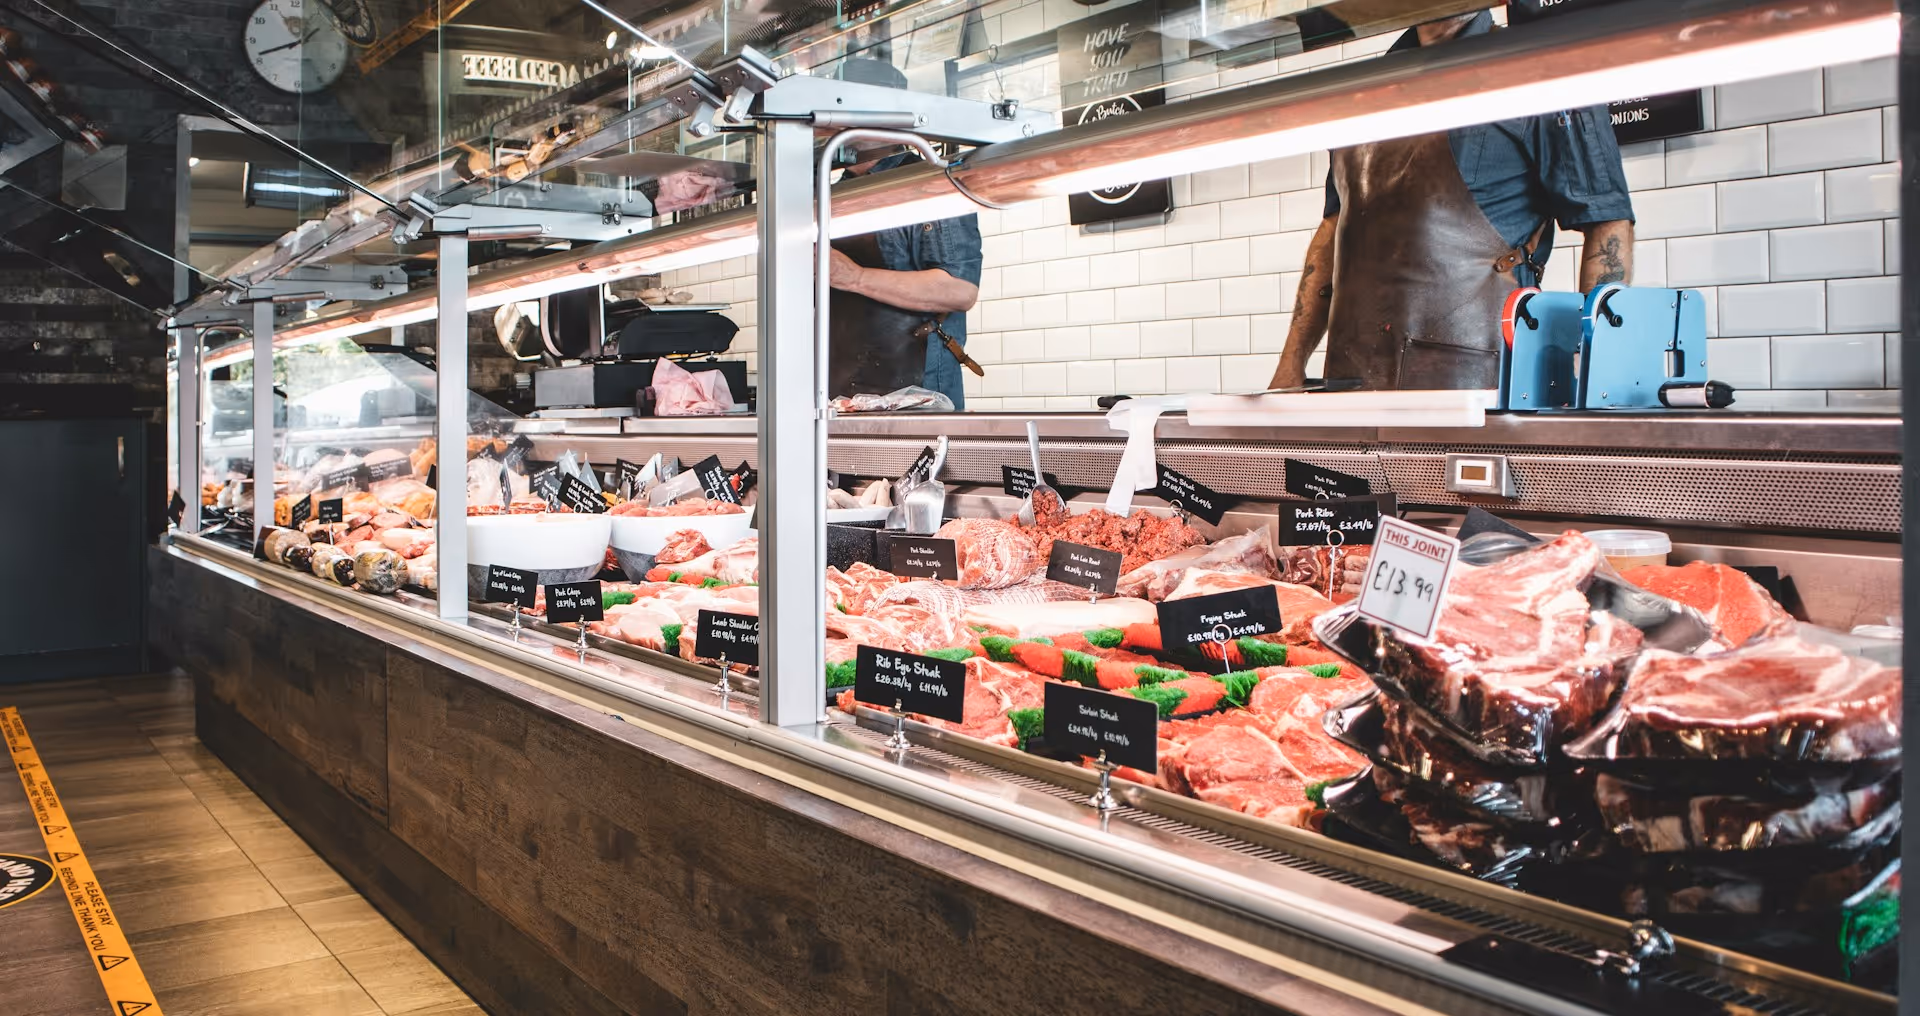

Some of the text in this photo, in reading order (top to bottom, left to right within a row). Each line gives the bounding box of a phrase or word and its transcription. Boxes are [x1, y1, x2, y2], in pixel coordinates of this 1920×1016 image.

[1090, 47, 1125, 72] YOU
[1179, 478, 1195, 491] Steak
[1295, 508, 1334, 519] Pork Ribs
[1295, 521, 1331, 532] £7.67/kg
[1385, 528, 1449, 559] THIS JOINT
[1373, 560, 1435, 603] £13.99
[554, 587, 581, 597] Pork Chops
[712, 615, 728, 627] Lamb
[729, 618, 753, 630] Shoulder
[1200, 609, 1247, 625] Frying Steak
[875, 653, 941, 679] Rib Eye Steak
[875, 673, 912, 692] £26.38/kg
[1078, 704, 1119, 722] Sirloin Steak
[0, 858, 35, 878] AND
[60, 866, 107, 951] BEHIND LINE THANK YOU
[84, 880, 115, 927] PLEASE STAY
